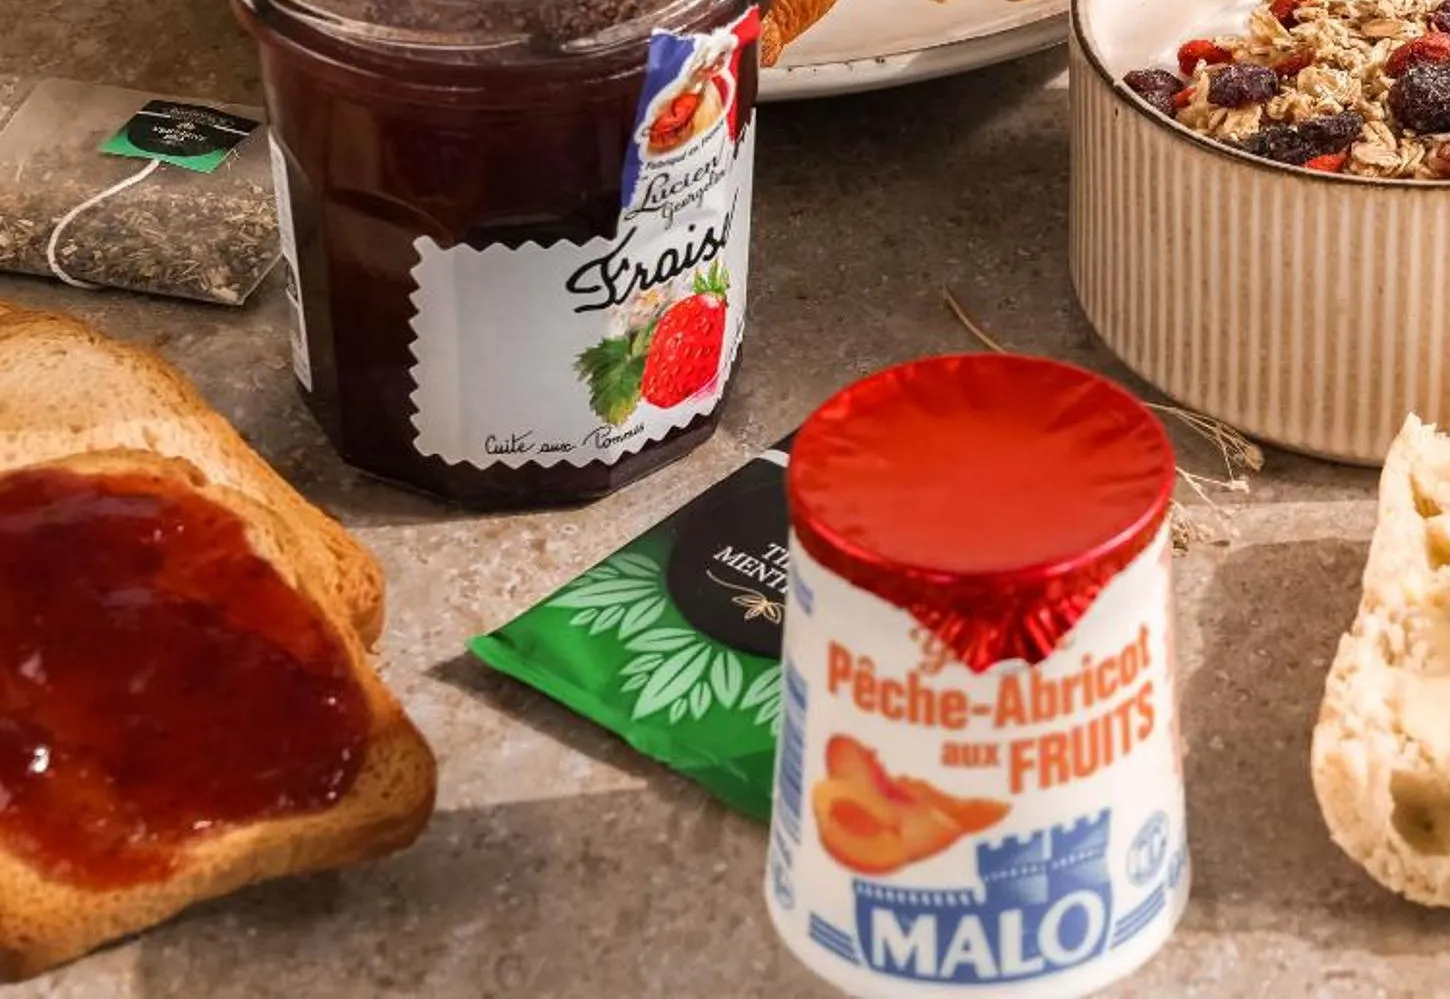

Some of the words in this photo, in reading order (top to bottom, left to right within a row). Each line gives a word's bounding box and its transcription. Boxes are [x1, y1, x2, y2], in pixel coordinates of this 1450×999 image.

[624, 155, 717, 221] Lucien
[827, 622, 1152, 731] Pêche-Abricot
[940, 739, 1000, 769] aux
[1008, 680, 1157, 796] FRUITS
[868, 888, 1105, 981] MALO
